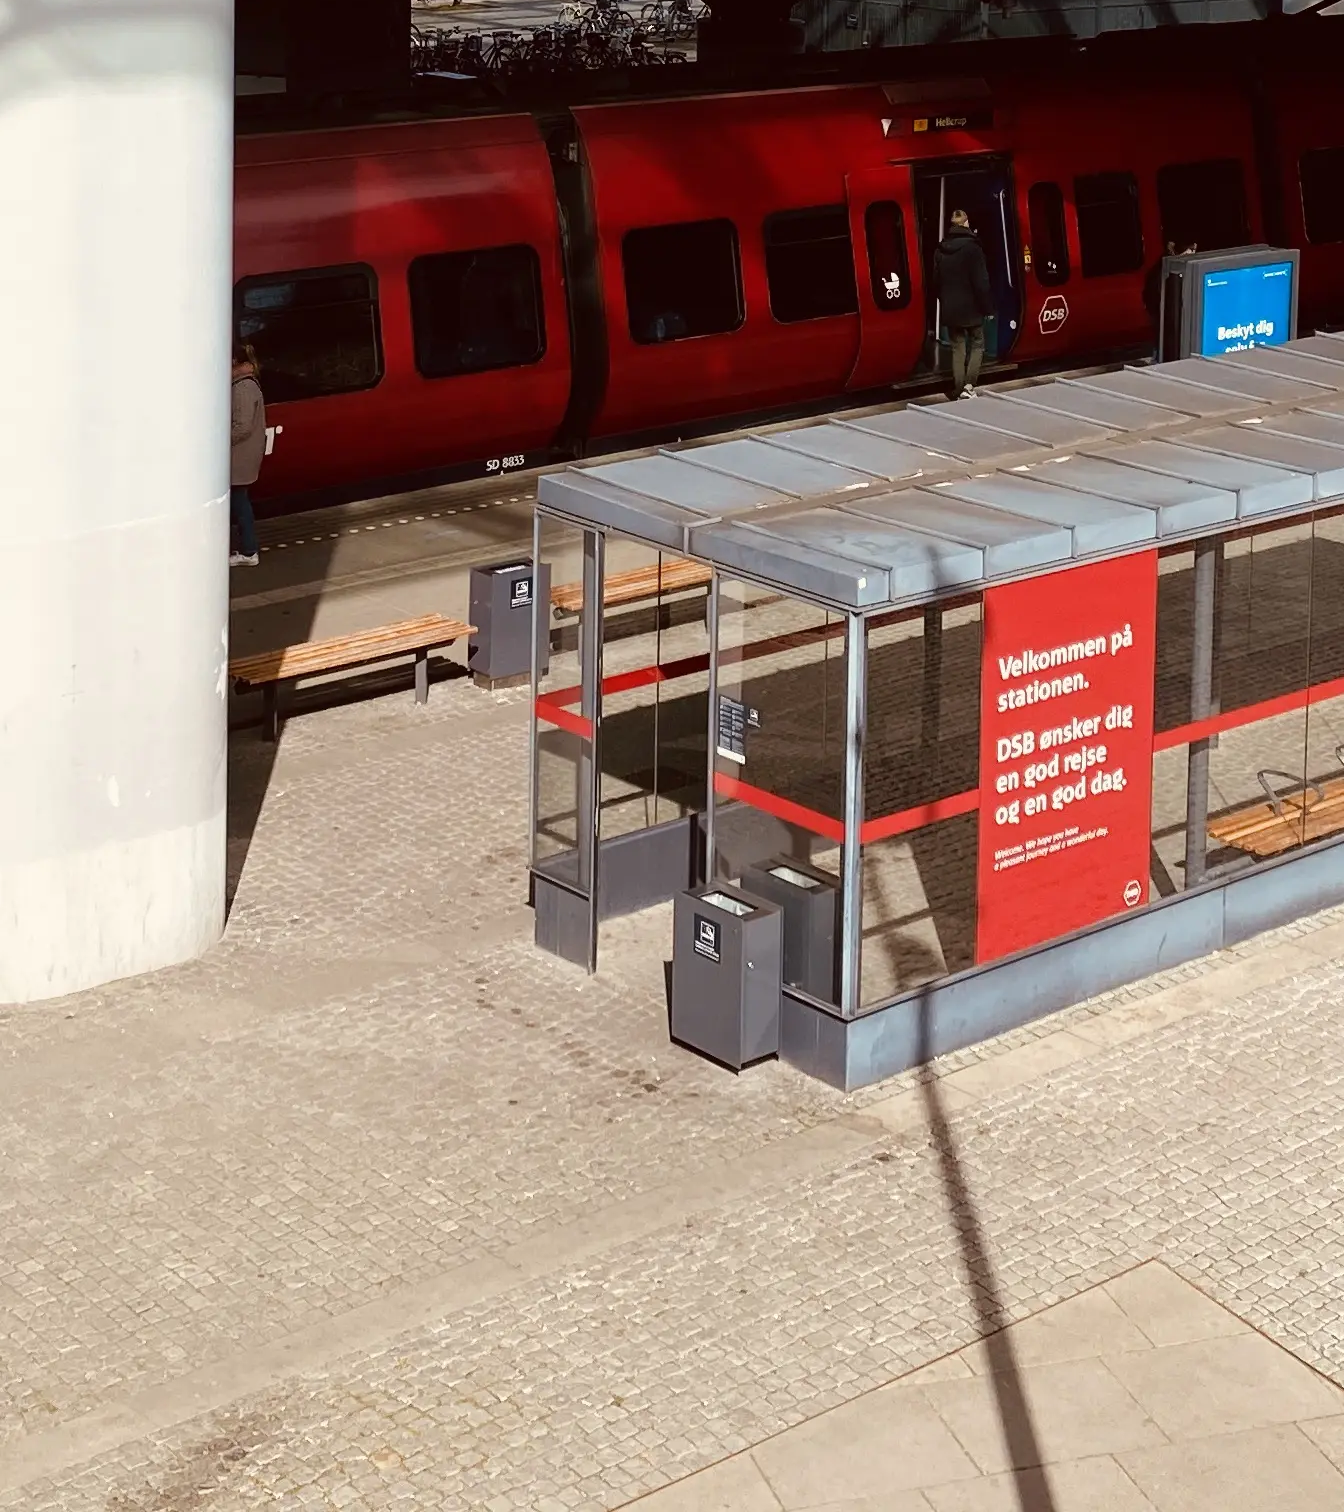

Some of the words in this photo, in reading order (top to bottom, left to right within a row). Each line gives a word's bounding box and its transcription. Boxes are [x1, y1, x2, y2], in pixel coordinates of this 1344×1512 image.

[1042, 308, 1065, 322] DSB
[1217, 322, 1255, 341] Beskyt
[1255, 319, 1274, 337] dig
[486, 459, 500, 471] SD
[501, 454, 525, 468] 8833
[998, 636, 1106, 681] Velkommen
[1110, 623, 1133, 656] på
[997, 672, 1090, 713] stationen.
[997, 731, 1035, 763] DSB
[1039, 716, 1101, 750] ønsker
[1105, 704, 1133, 730] dig
[996, 770, 1019, 794] en
[1023, 753, 1059, 788] god
[1063, 745, 1107, 774] rejse
[995, 800, 1020, 825] og
[1024, 793, 1047, 816] en
[1051, 776, 1087, 810] god
[1090, 767, 1128, 795] dag.
